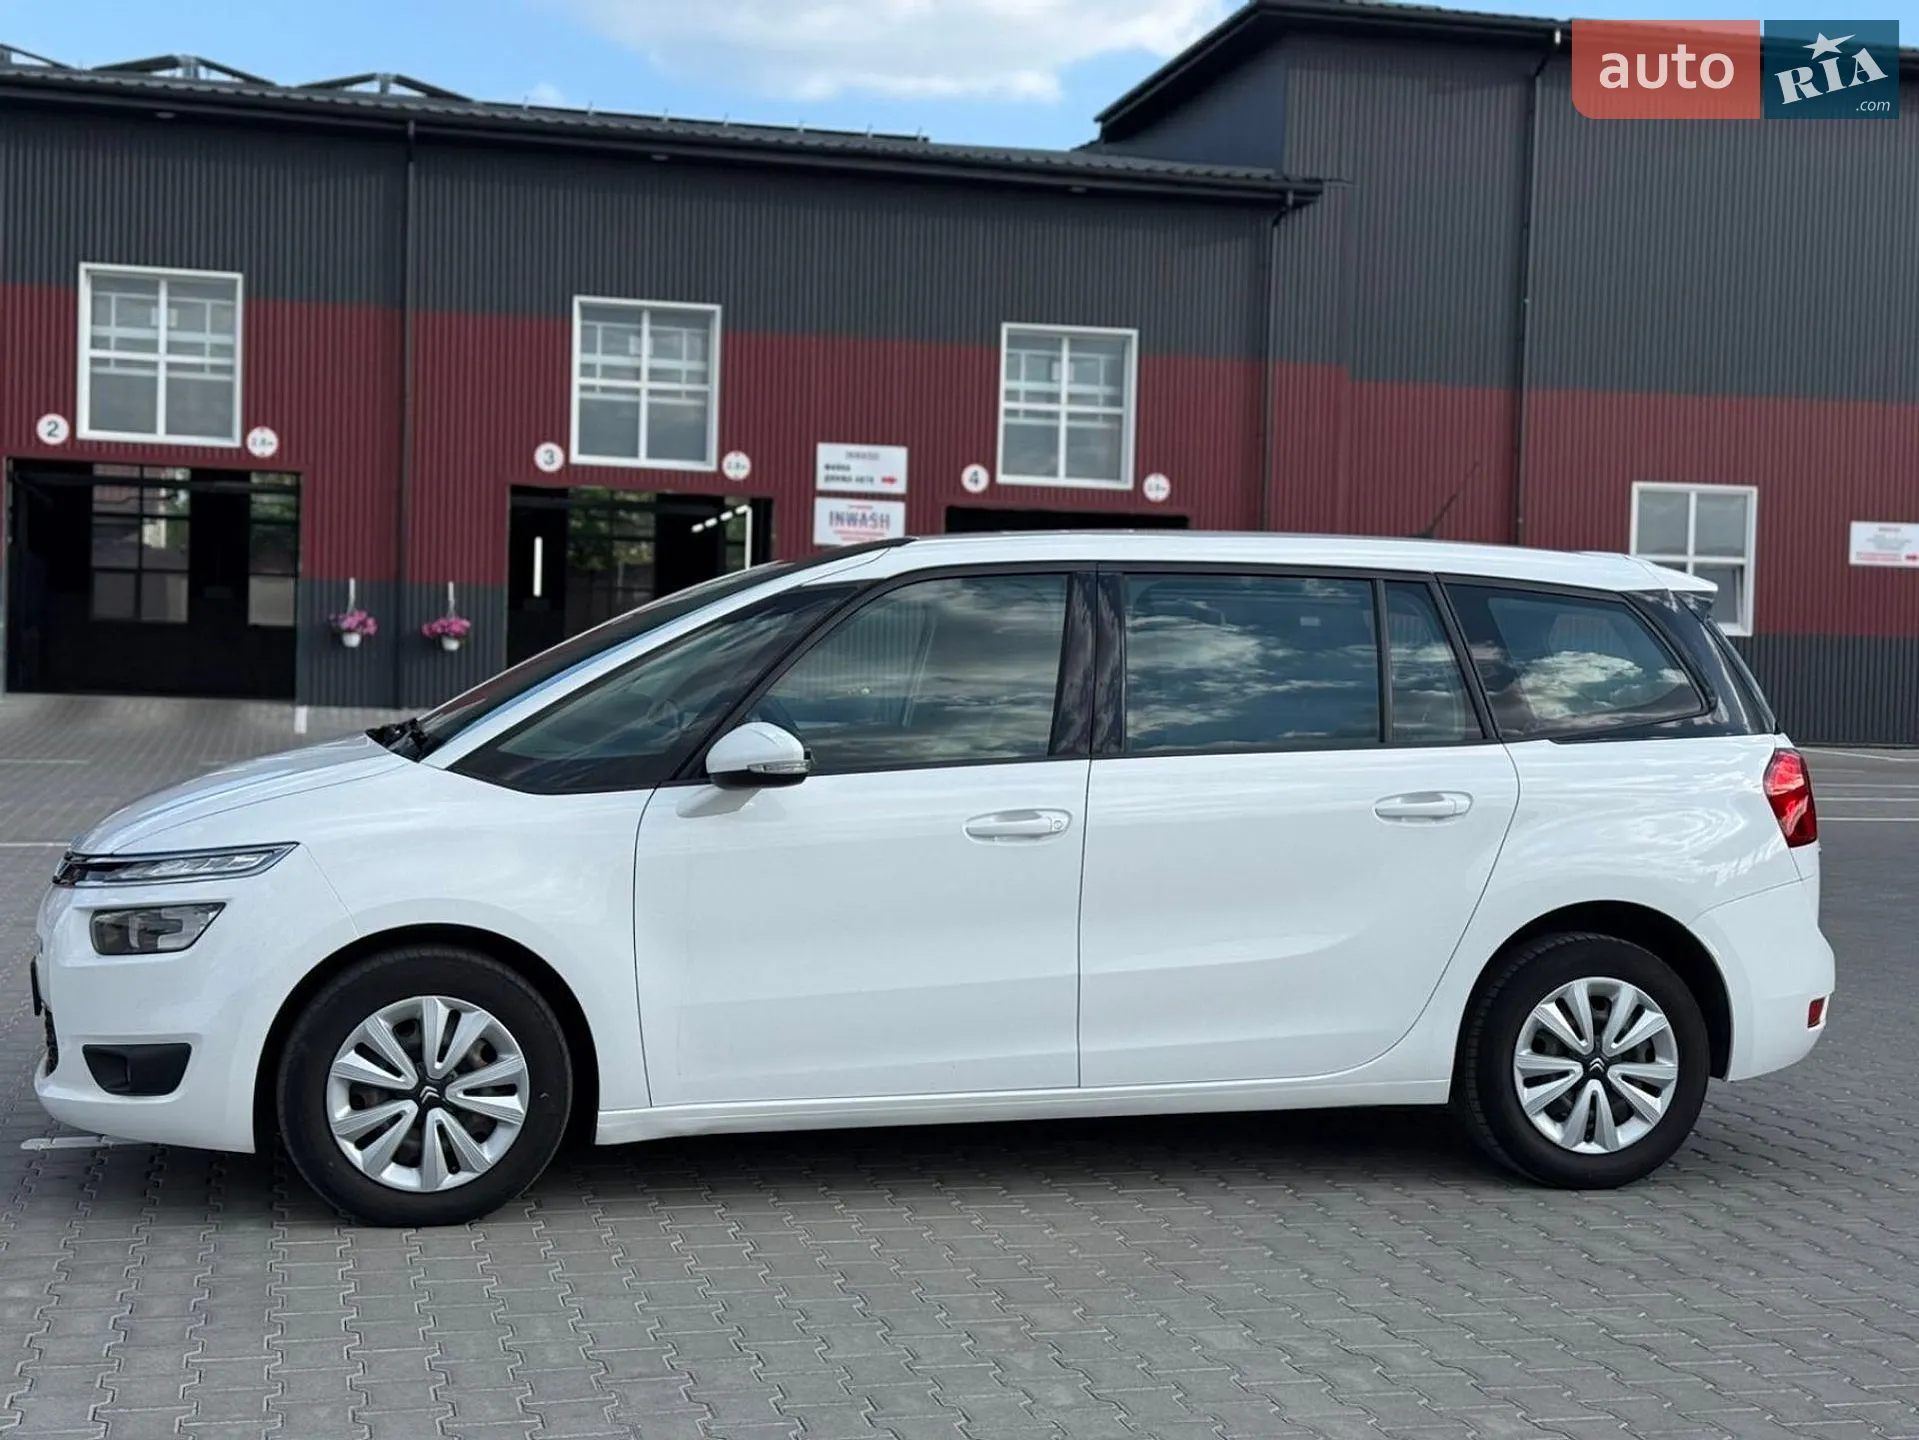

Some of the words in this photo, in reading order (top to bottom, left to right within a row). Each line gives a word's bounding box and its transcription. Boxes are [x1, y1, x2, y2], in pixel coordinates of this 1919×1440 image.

[47, 419, 59, 438] 2
[543, 449, 555, 466] 3
[968, 470, 979, 486] 4
[829, 509, 890, 531] INWASH
